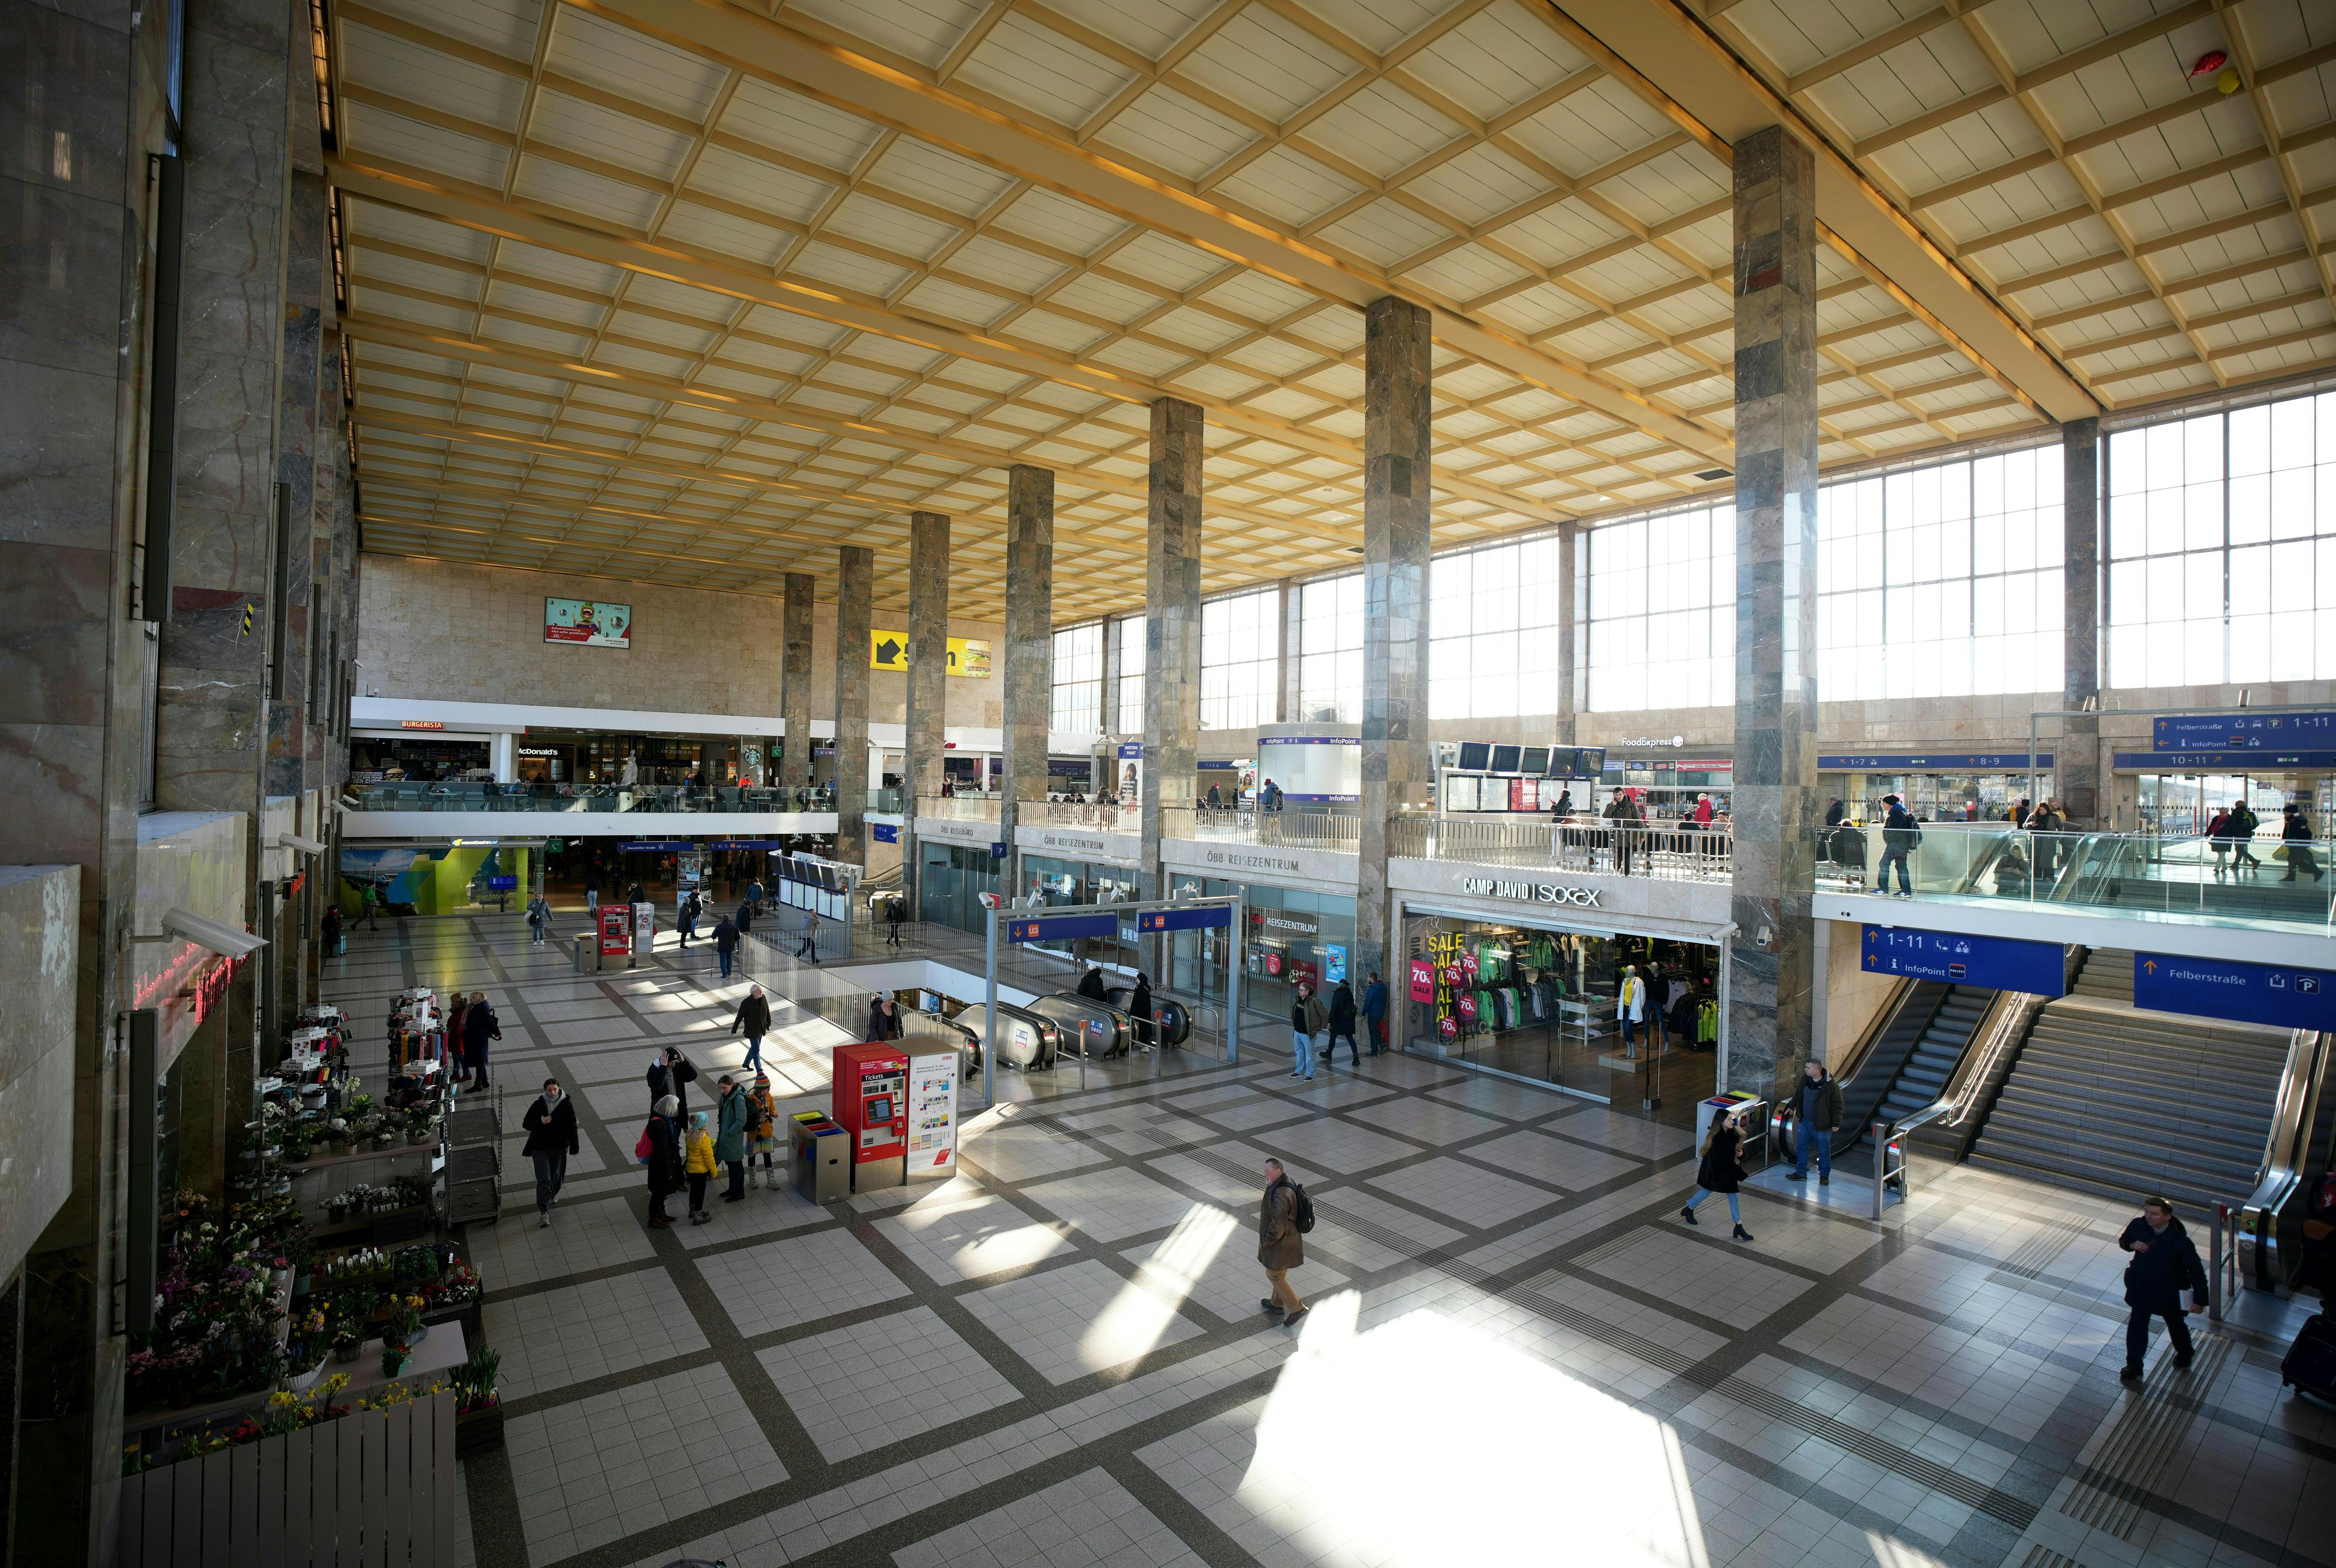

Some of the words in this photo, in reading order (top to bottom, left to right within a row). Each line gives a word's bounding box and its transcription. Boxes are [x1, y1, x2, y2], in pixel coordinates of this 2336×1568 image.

[402, 721, 442, 729] BURGERISTA
[1622, 737, 1673, 748] FoodExpress
[951, 827, 973, 836] REISEBÜRO
[1045, 835, 1055, 844] ÖBB
[1059, 838, 1104, 850] REISEZENTRUM
[1207, 850, 1223, 863] ÖBB
[1229, 854, 1298, 871] REISEZENTRUM
[1043, 882, 1062, 890] REISEBÜRO
[1464, 878, 1493, 895] CAMP
[1497, 881, 1528, 899] DAVID
[1267, 918, 1316, 933] REISEZENTRUM
[1429, 933, 1463, 952] SALE
[1464, 959, 1477, 969] 70%
[1413, 969, 1430, 983] 70%
[1447, 970, 1460, 981] 70%
[1905, 965, 1945, 976] InfoPoint
[2170, 969, 2246, 985] Felberstraße
[1413, 986, 1430, 994] SALE
[1461, 1001, 1474, 1011] 70%
[1442, 1021, 1455, 1032] 70%
